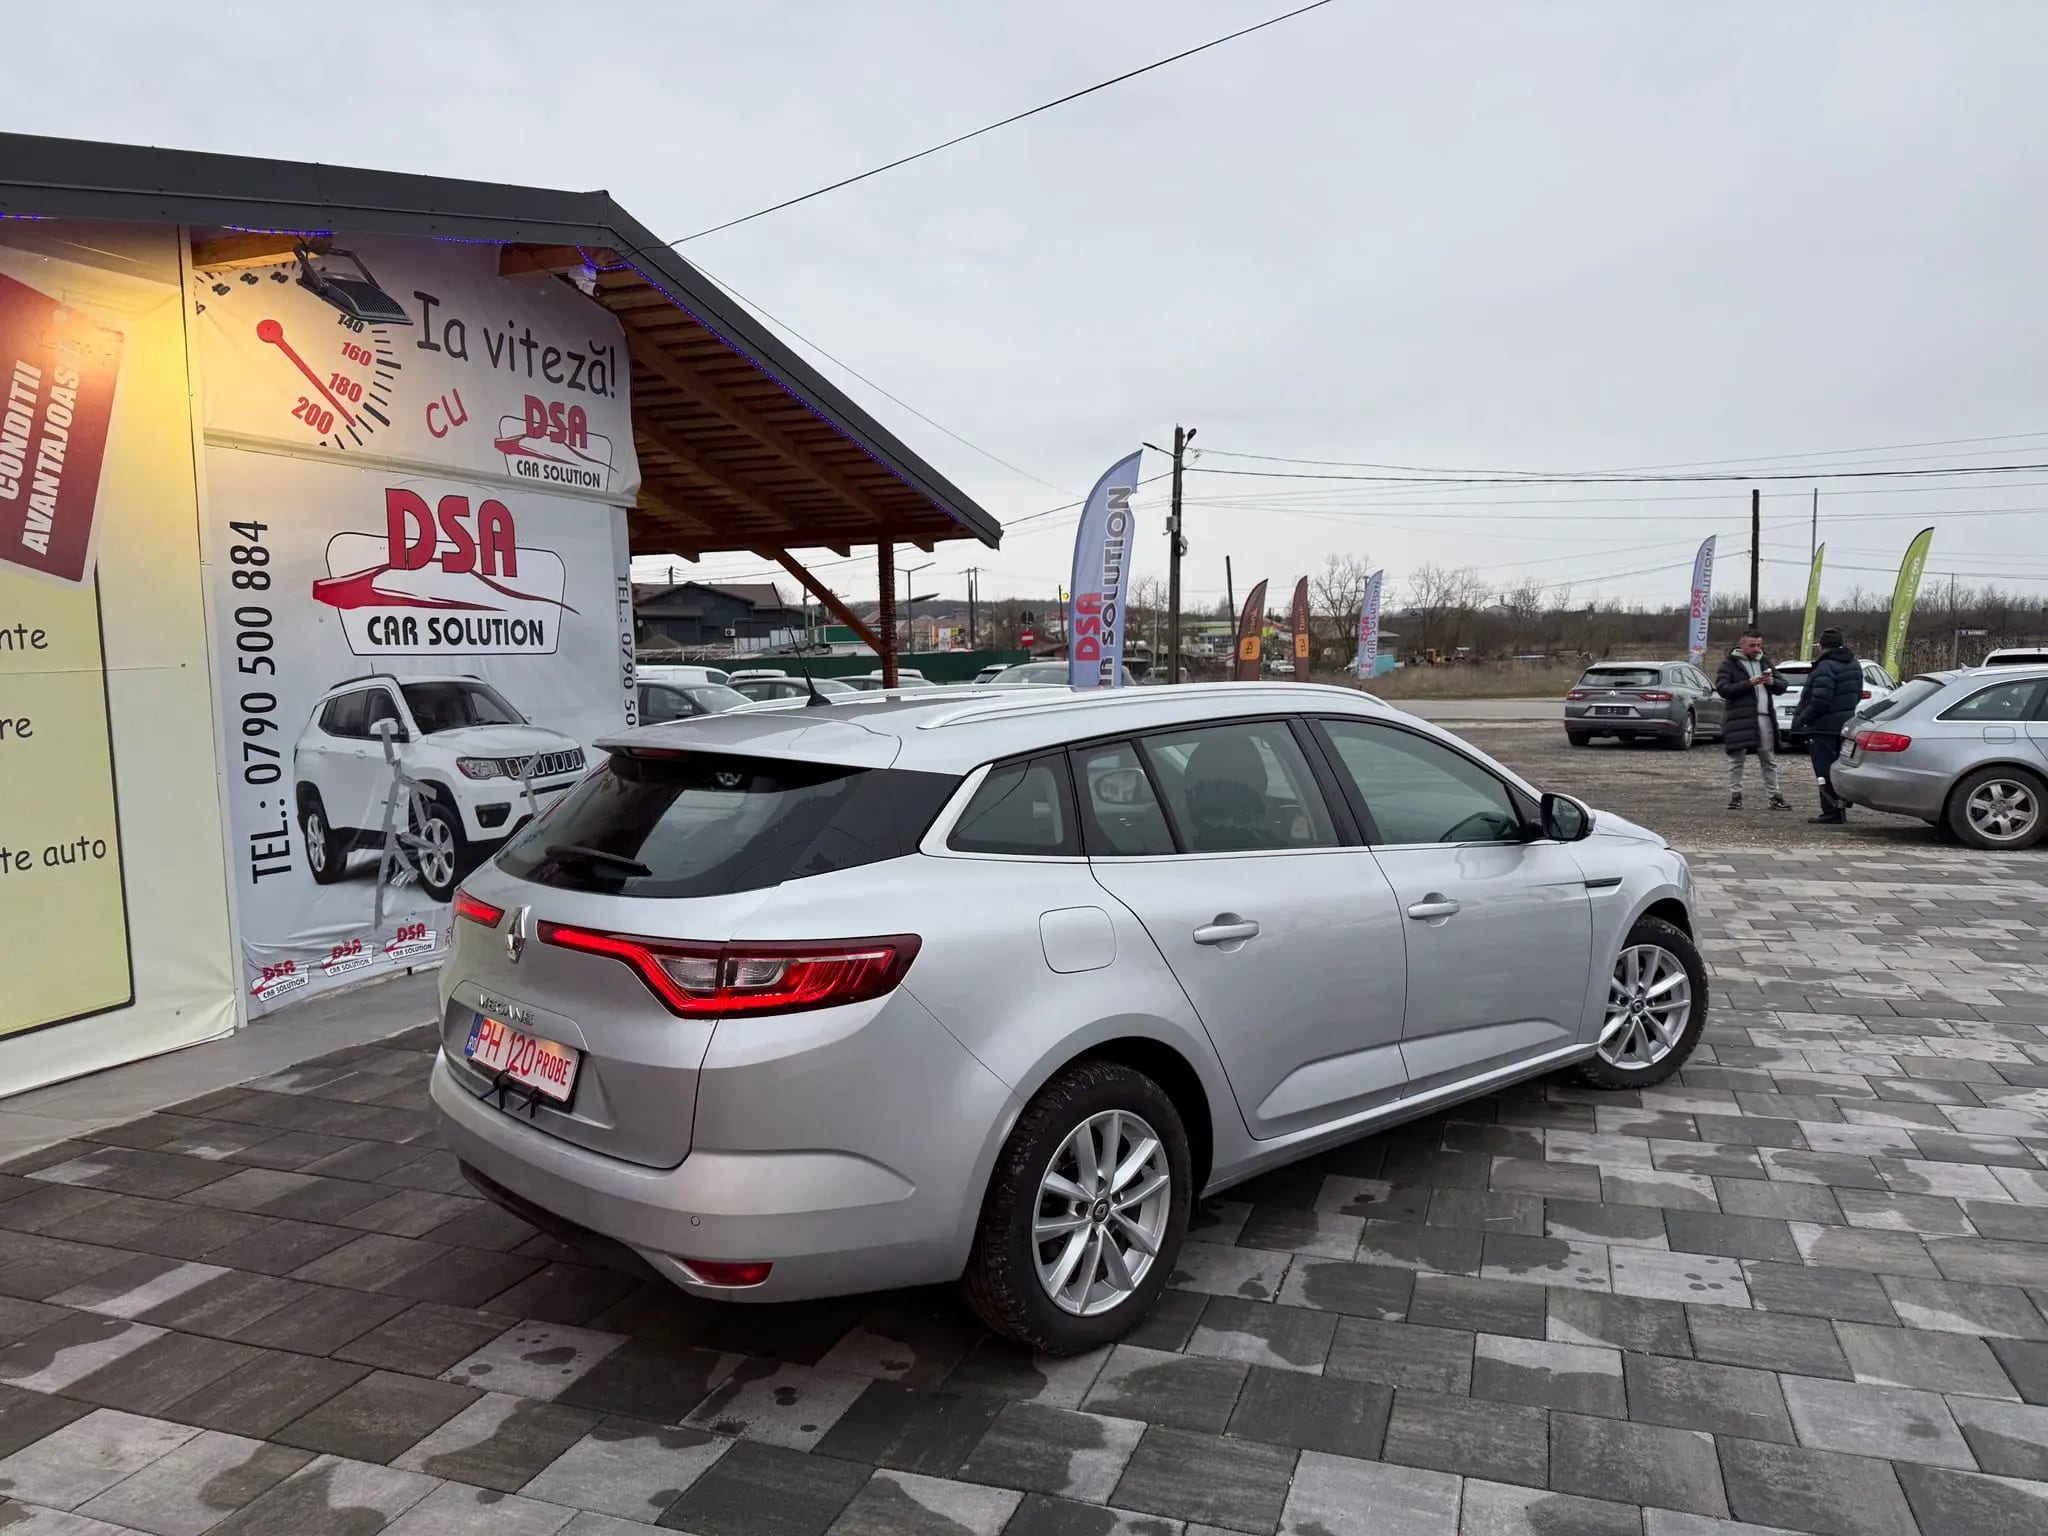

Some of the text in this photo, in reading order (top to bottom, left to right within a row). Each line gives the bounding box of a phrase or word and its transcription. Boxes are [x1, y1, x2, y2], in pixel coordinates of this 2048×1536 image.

[337, 313, 364, 334] 140
[341, 342, 373, 367] 160
[413, 290, 616, 399] Ia viteză!
[328, 372, 363, 403] 180
[291, 396, 335, 435] 200
[426, 388, 468, 438] cu
[524, 394, 588, 449] DSA
[516, 460, 600, 488] CAR SOLUTION
[385, 487, 518, 578] DSA
[229, 520, 271, 592] 884
[1101, 487, 1132, 648] SOLUTION
[234, 606, 276, 676] 500
[367, 615, 544, 646] CAR SOLUTION
[1075, 592, 1102, 662] DSA
[621, 632, 635, 690] 0790
[240, 692, 283, 786] 0790
[43, 836, 107, 867] auto
[332, 938, 362, 960] DSA
[397, 922, 426, 943] DSA
[404, 943, 432, 955] SOLUTION
[262, 959, 296, 981] DSA
[341, 958, 370, 972] SOLUTION
[275, 977, 306, 995] SOLUTION
[475, 1019, 571, 1086] PH 120 PROBE
